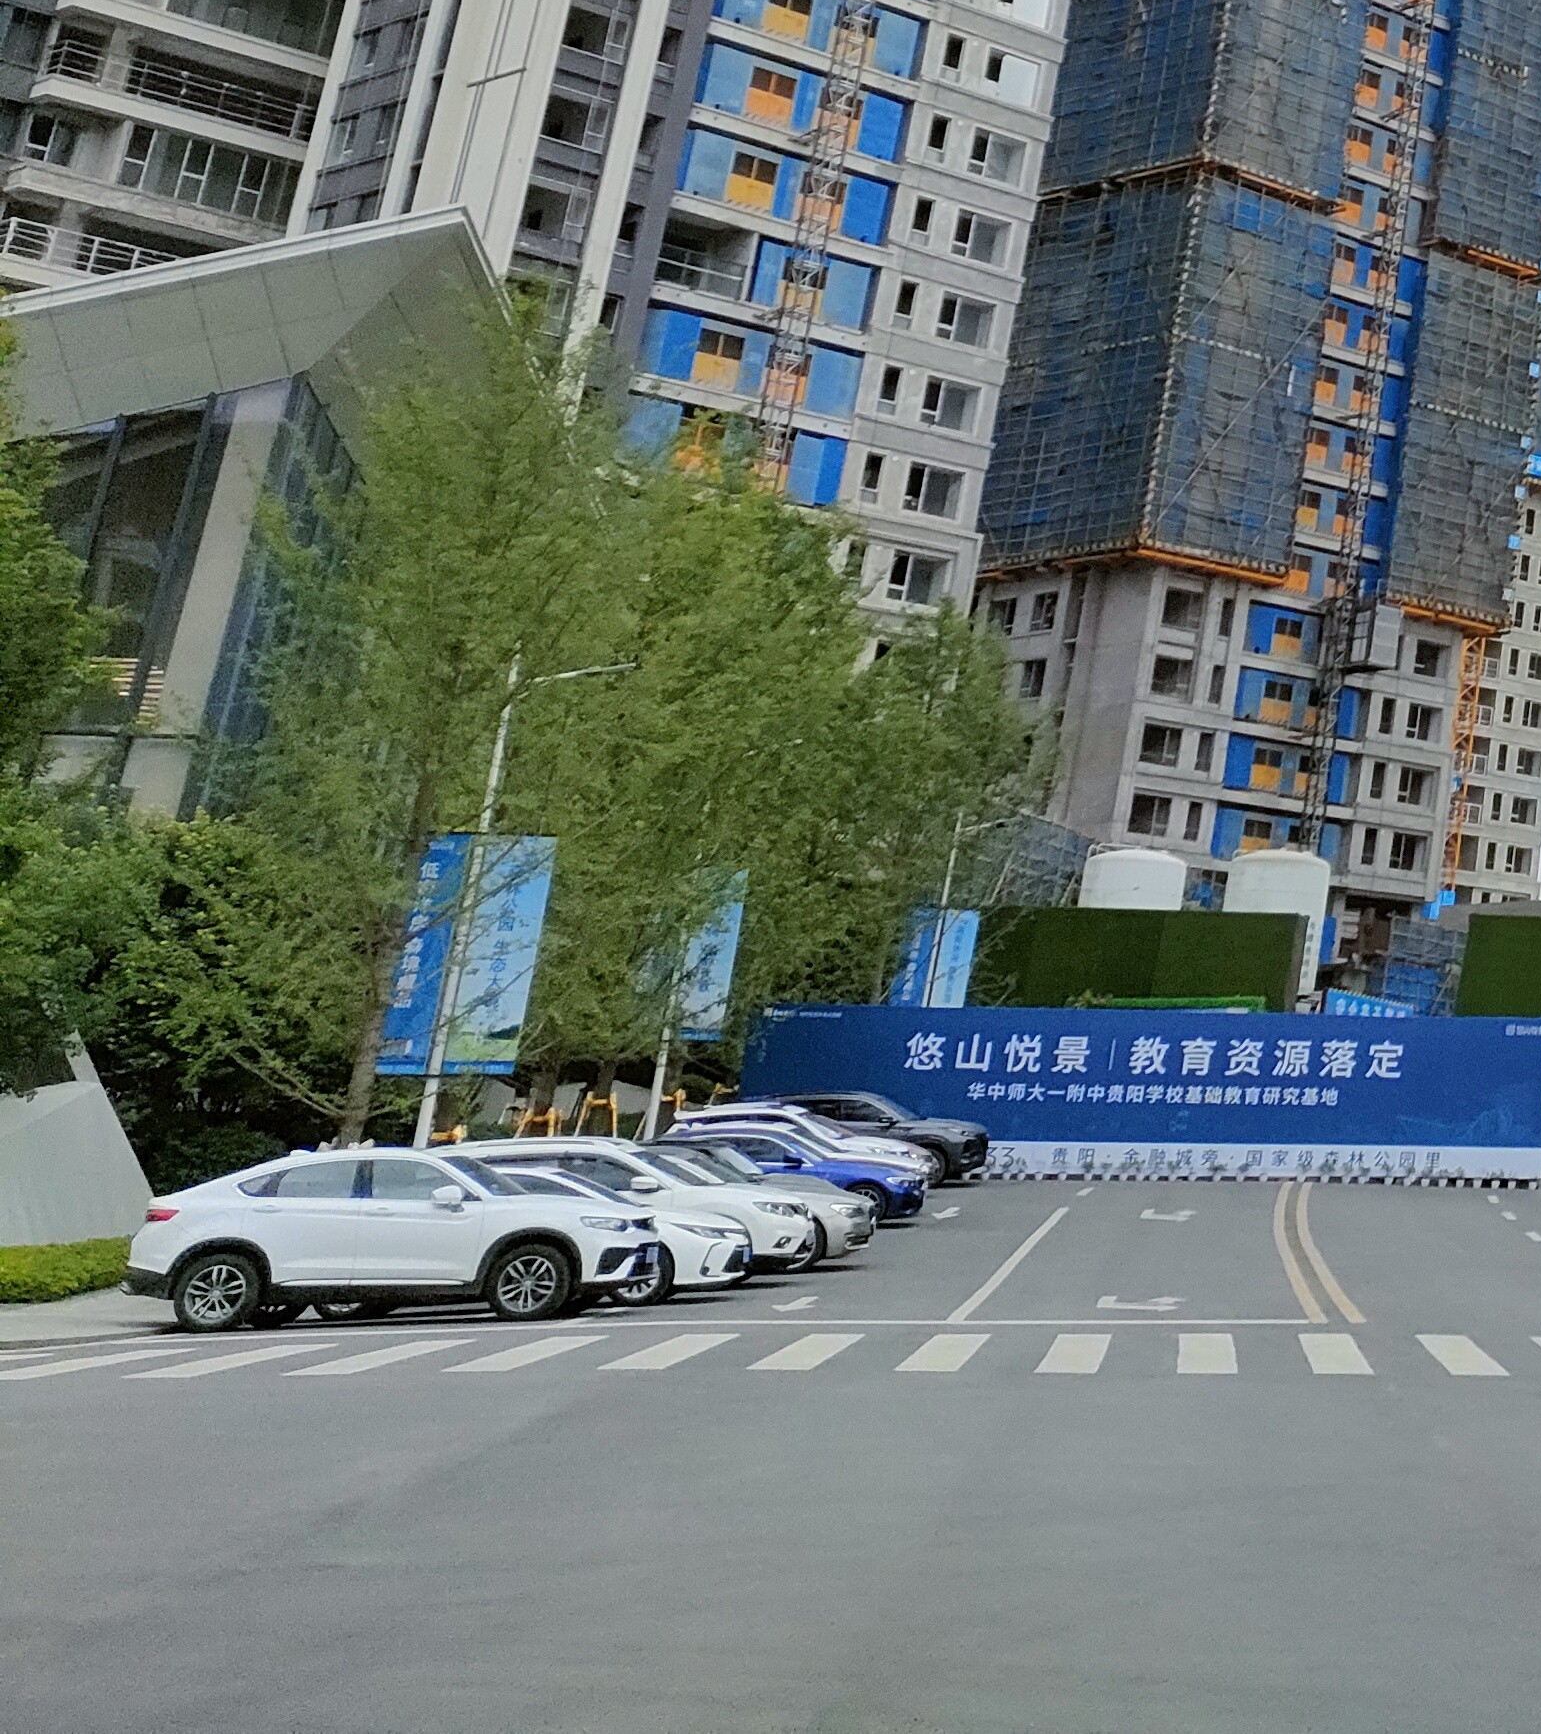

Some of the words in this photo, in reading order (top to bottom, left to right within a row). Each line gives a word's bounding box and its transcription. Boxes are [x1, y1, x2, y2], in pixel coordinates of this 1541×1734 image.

[904, 1032, 1091, 1074] 悠山悦景
[1129, 1035, 1404, 1079] 教育资源落定
[966, 1081, 1339, 1107] 华中师大一附中贵阳学校基础教育研究基地
